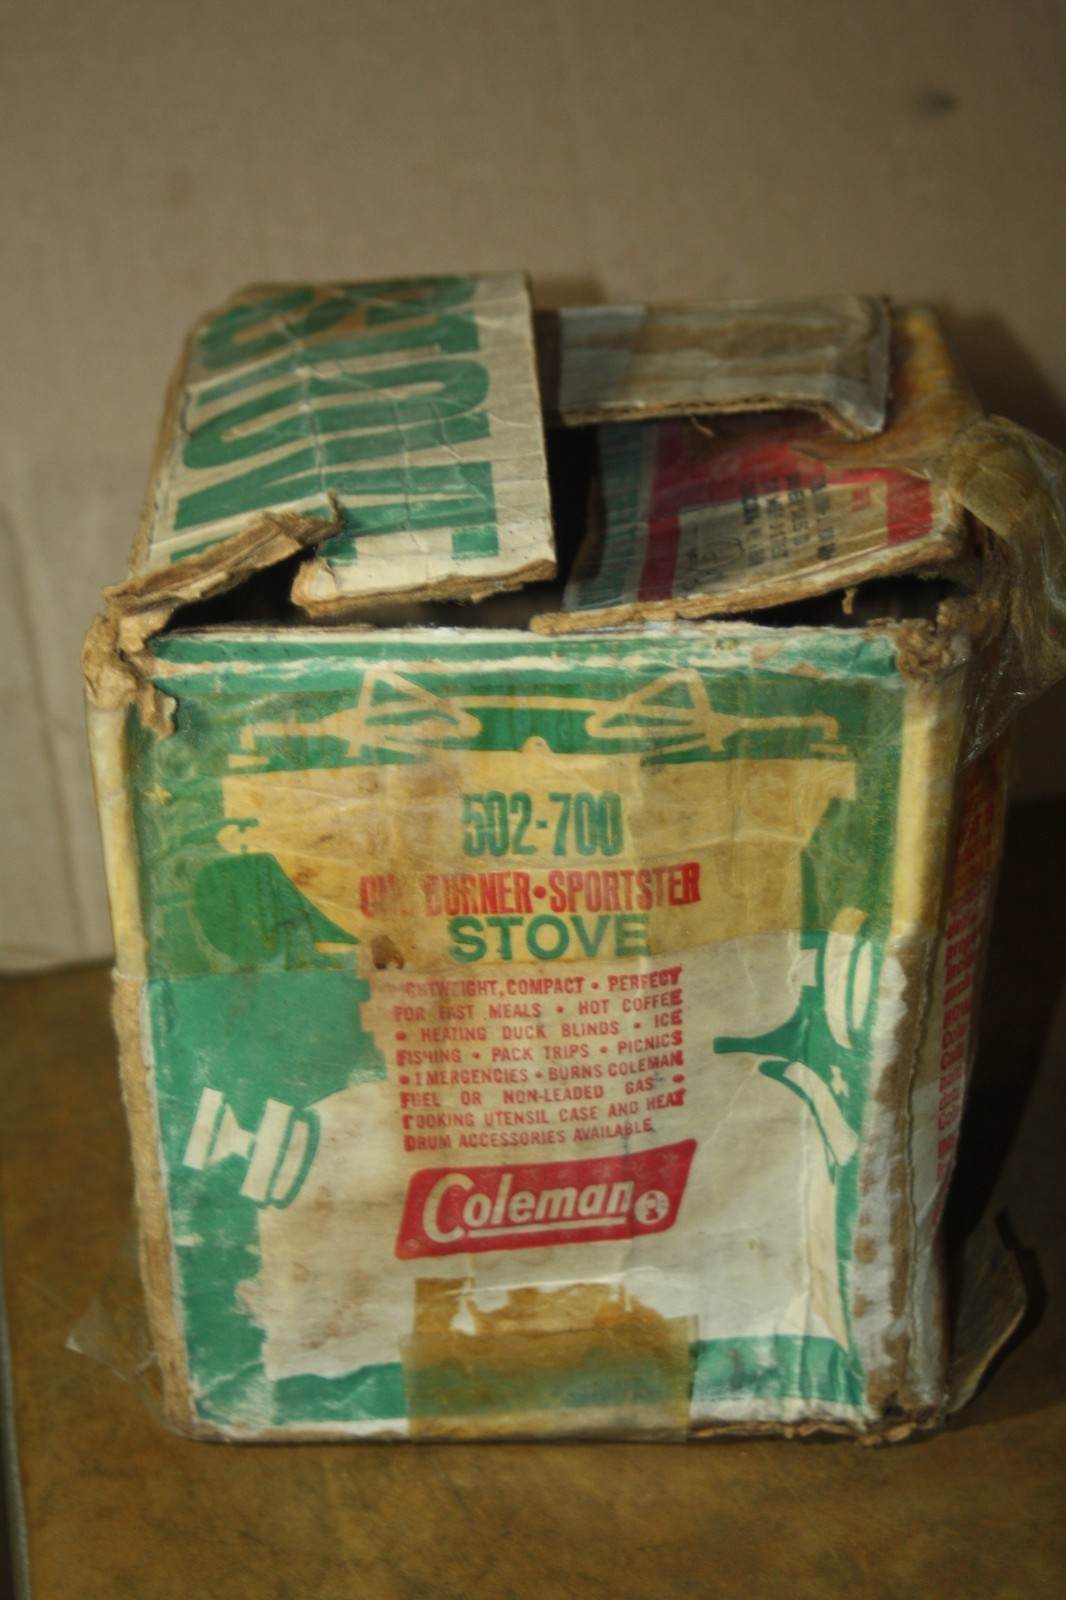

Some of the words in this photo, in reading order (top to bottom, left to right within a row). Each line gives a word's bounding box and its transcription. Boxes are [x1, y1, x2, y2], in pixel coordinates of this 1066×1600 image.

[461, 791, 624, 857] 502-700
[424, 871, 533, 917] BURNER
[548, 861, 702, 913] SPORTSTER
[447, 914, 651, 963] STOVE
[506, 977, 584, 997] COMPACT
[607, 966, 682, 992] PERFECT
[393, 1005, 425, 1022] FOR
[488, 1003, 542, 1020] MEALS
[578, 999, 609, 1015] HOT
[622, 988, 683, 1013] COFFEE
[421, 1026, 487, 1042] HEATING
[502, 1025, 546, 1040] DUCK
[561, 1021, 619, 1038] BLINDS
[654, 1009, 683, 1028] ICE
[396, 1049, 462, 1068] FISHING
[491, 1047, 533, 1062] PACK
[543, 1043, 589, 1061] TRIPS
[617, 1030, 683, 1055] PICNICS
[548, 1064, 602, 1081] BURNS
[608, 1049, 683, 1077] COLEMAN
[400, 1091, 441, 1109] FUEL
[461, 1090, 482, 1106] OR
[503, 1084, 604, 1105] NON-LEADED
[625, 1077, 655, 1095] GAS
[485, 1109, 550, 1127] UTENSIL
[559, 1106, 598, 1122] CASE
[608, 1101, 638, 1118] AND
[646, 1087, 686, 1111] HEAT
[404, 1134, 452, 1152] DRUM
[459, 1130, 566, 1149] ACCESSORIES
[422, 1172, 635, 1244] Coleman
